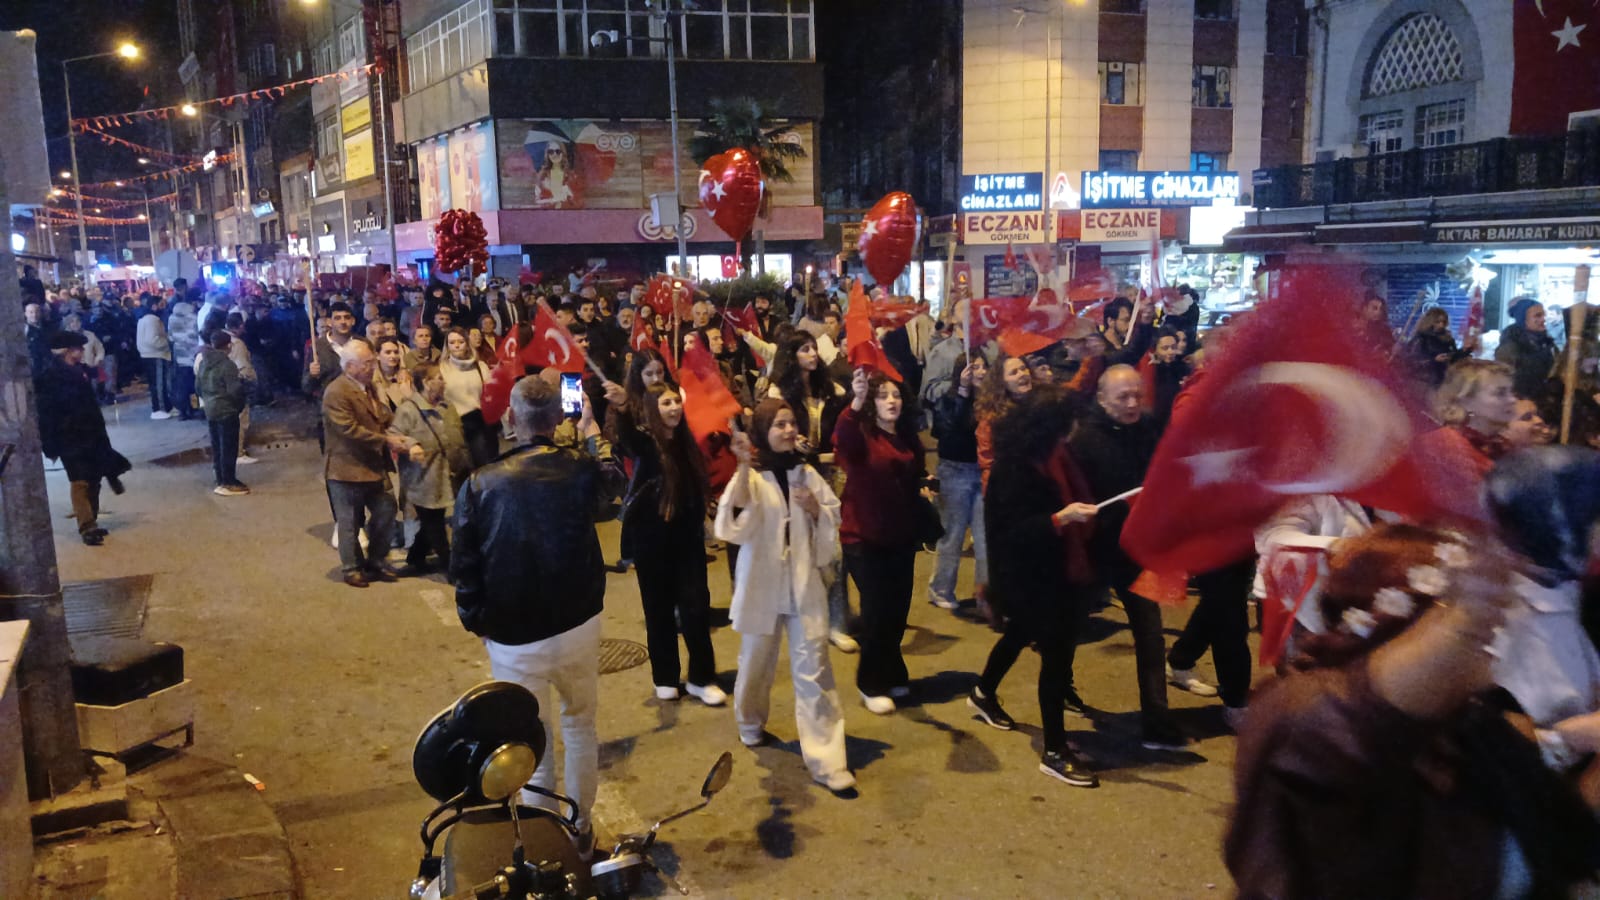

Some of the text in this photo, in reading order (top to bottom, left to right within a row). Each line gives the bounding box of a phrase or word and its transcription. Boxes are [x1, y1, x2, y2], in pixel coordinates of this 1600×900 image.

[597, 134, 634, 150] eve
[974, 174, 1026, 192] İŞİTME
[1085, 172, 1145, 203] İŞİTME
[1151, 172, 1239, 199] CİHAZLARI
[961, 193, 1040, 209] CİHAZLARI
[967, 214, 1053, 232] ECZANE
[1085, 211, 1157, 229] ECZANE
[990, 233, 1030, 241] GÖKMEN
[1105, 230, 1138, 238] GÖKMEN
